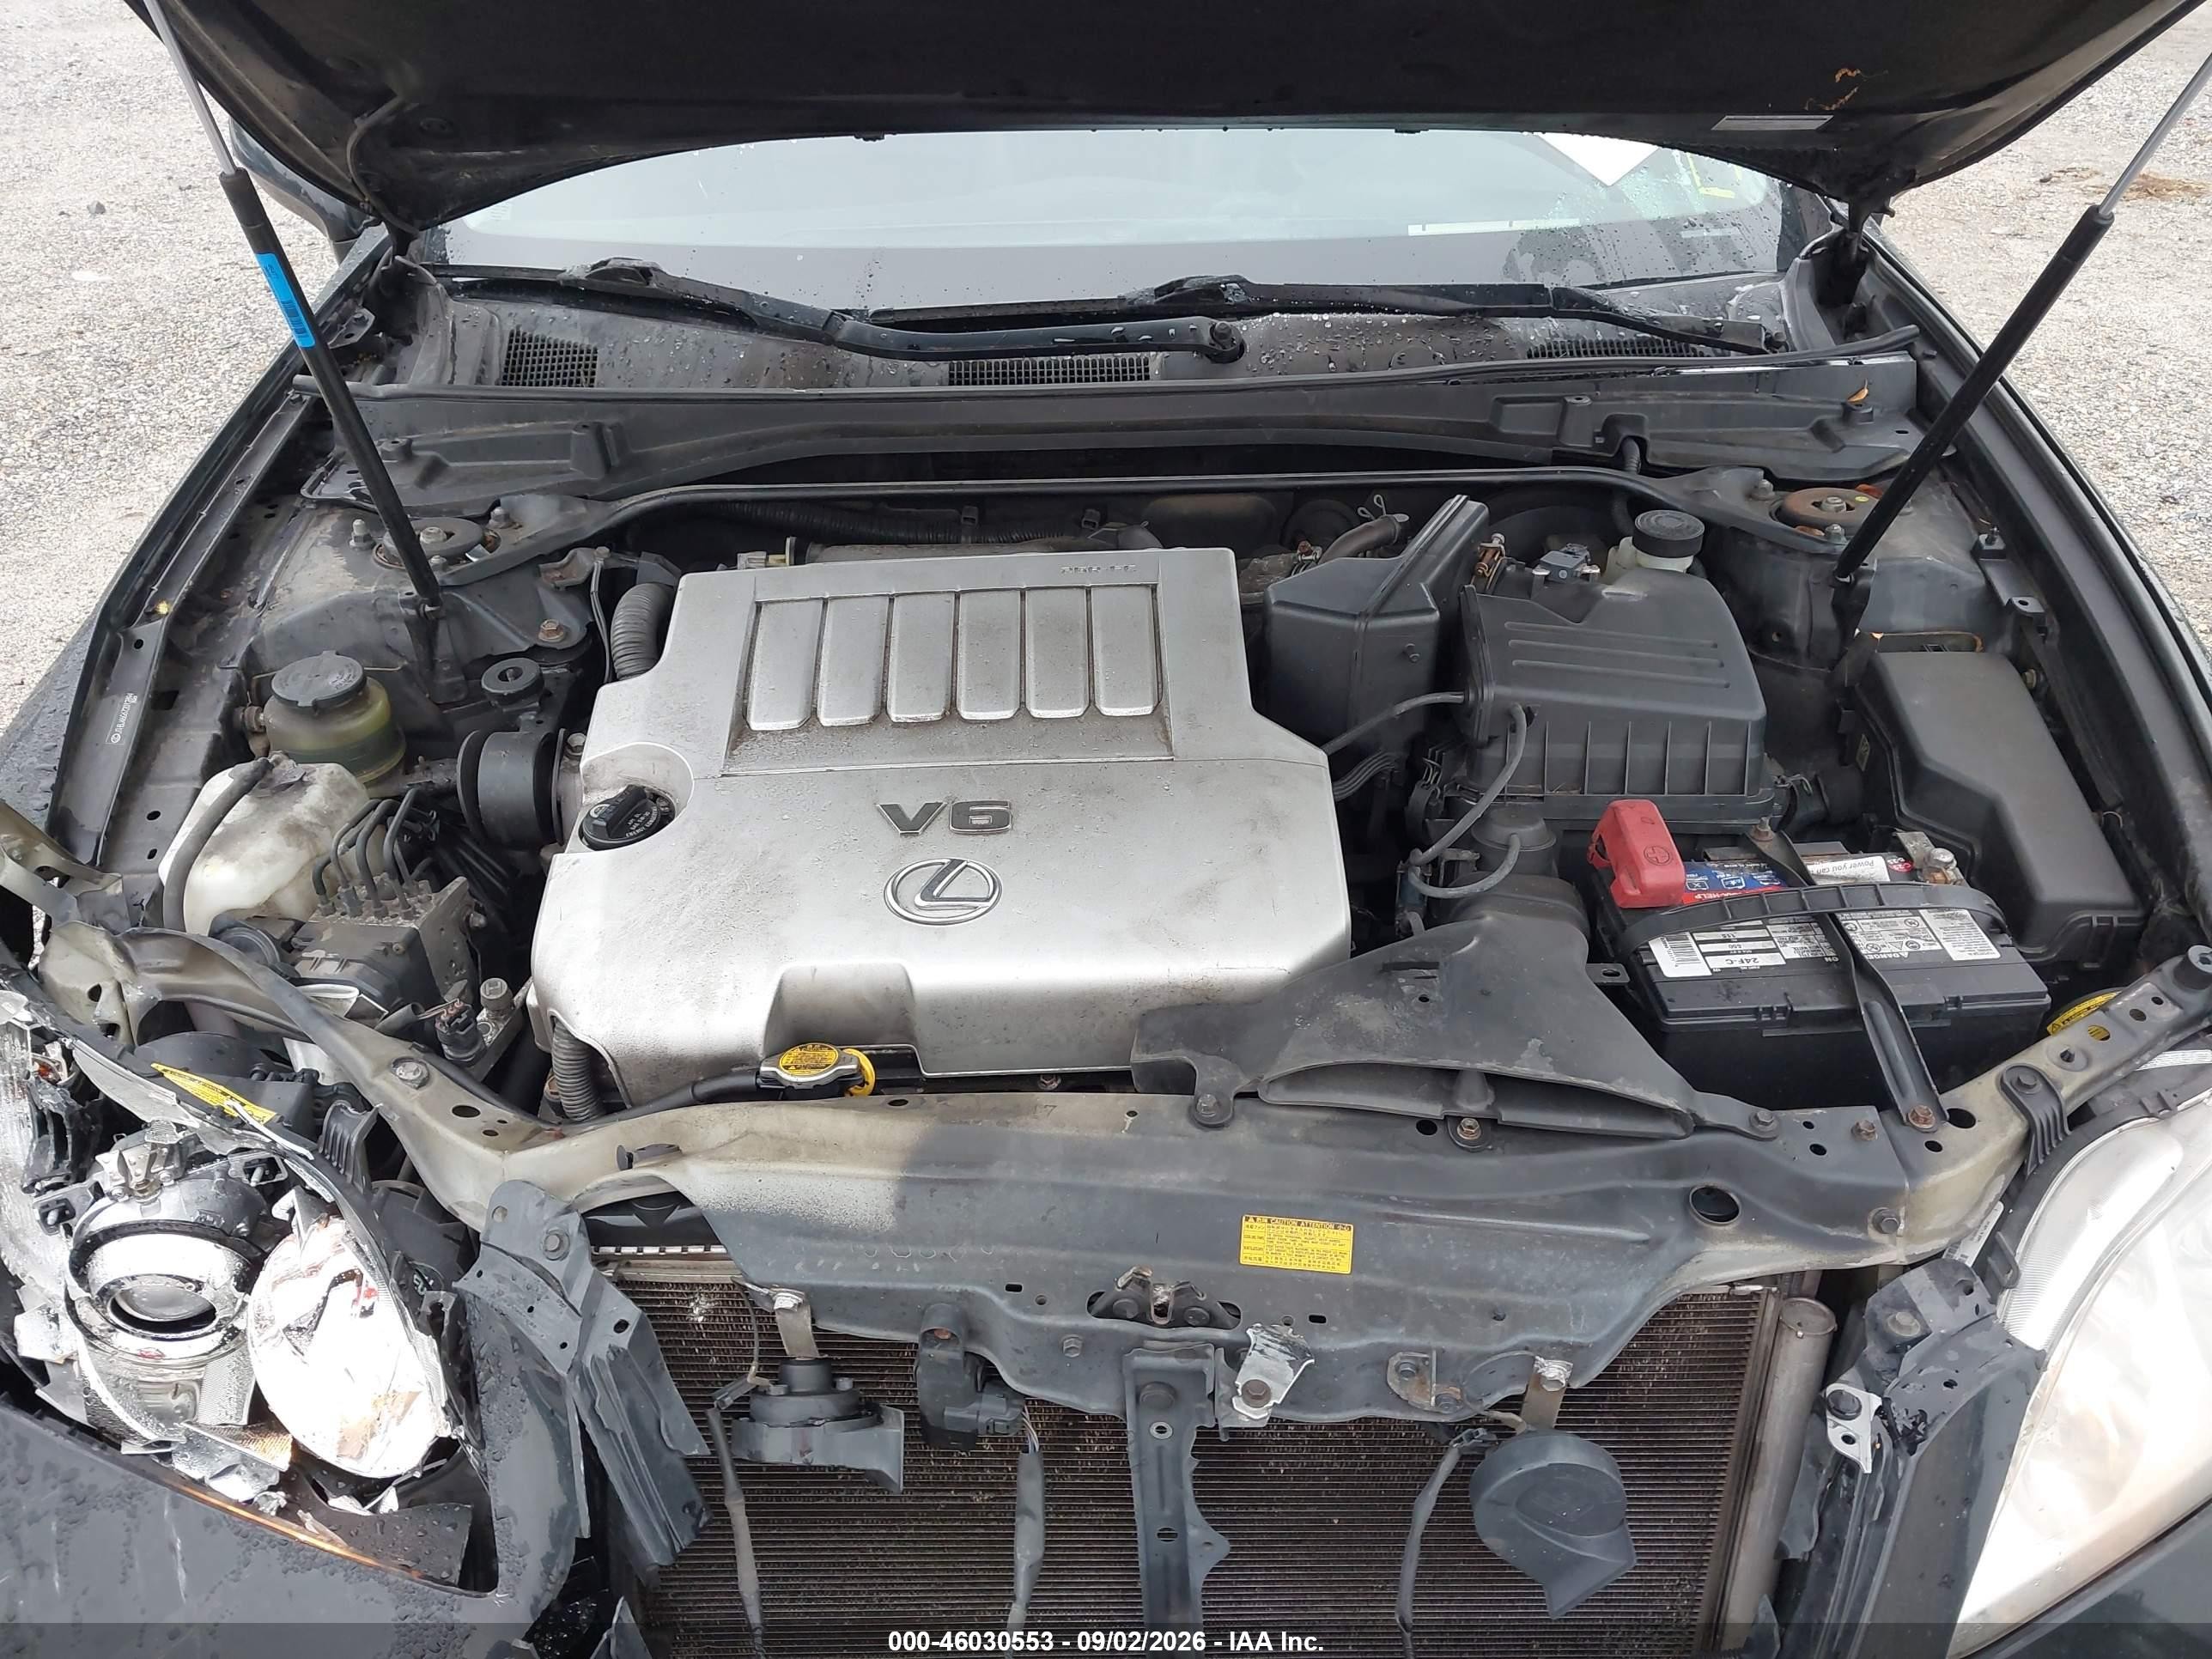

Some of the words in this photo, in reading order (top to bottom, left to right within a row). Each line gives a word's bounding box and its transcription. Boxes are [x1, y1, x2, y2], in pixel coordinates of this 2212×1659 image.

[878, 800, 1012, 835] V6
[1832, 863, 1848, 872] you
[1849, 860, 1875, 869] Power
[1300, 1221, 1334, 1230] ATTENTION
